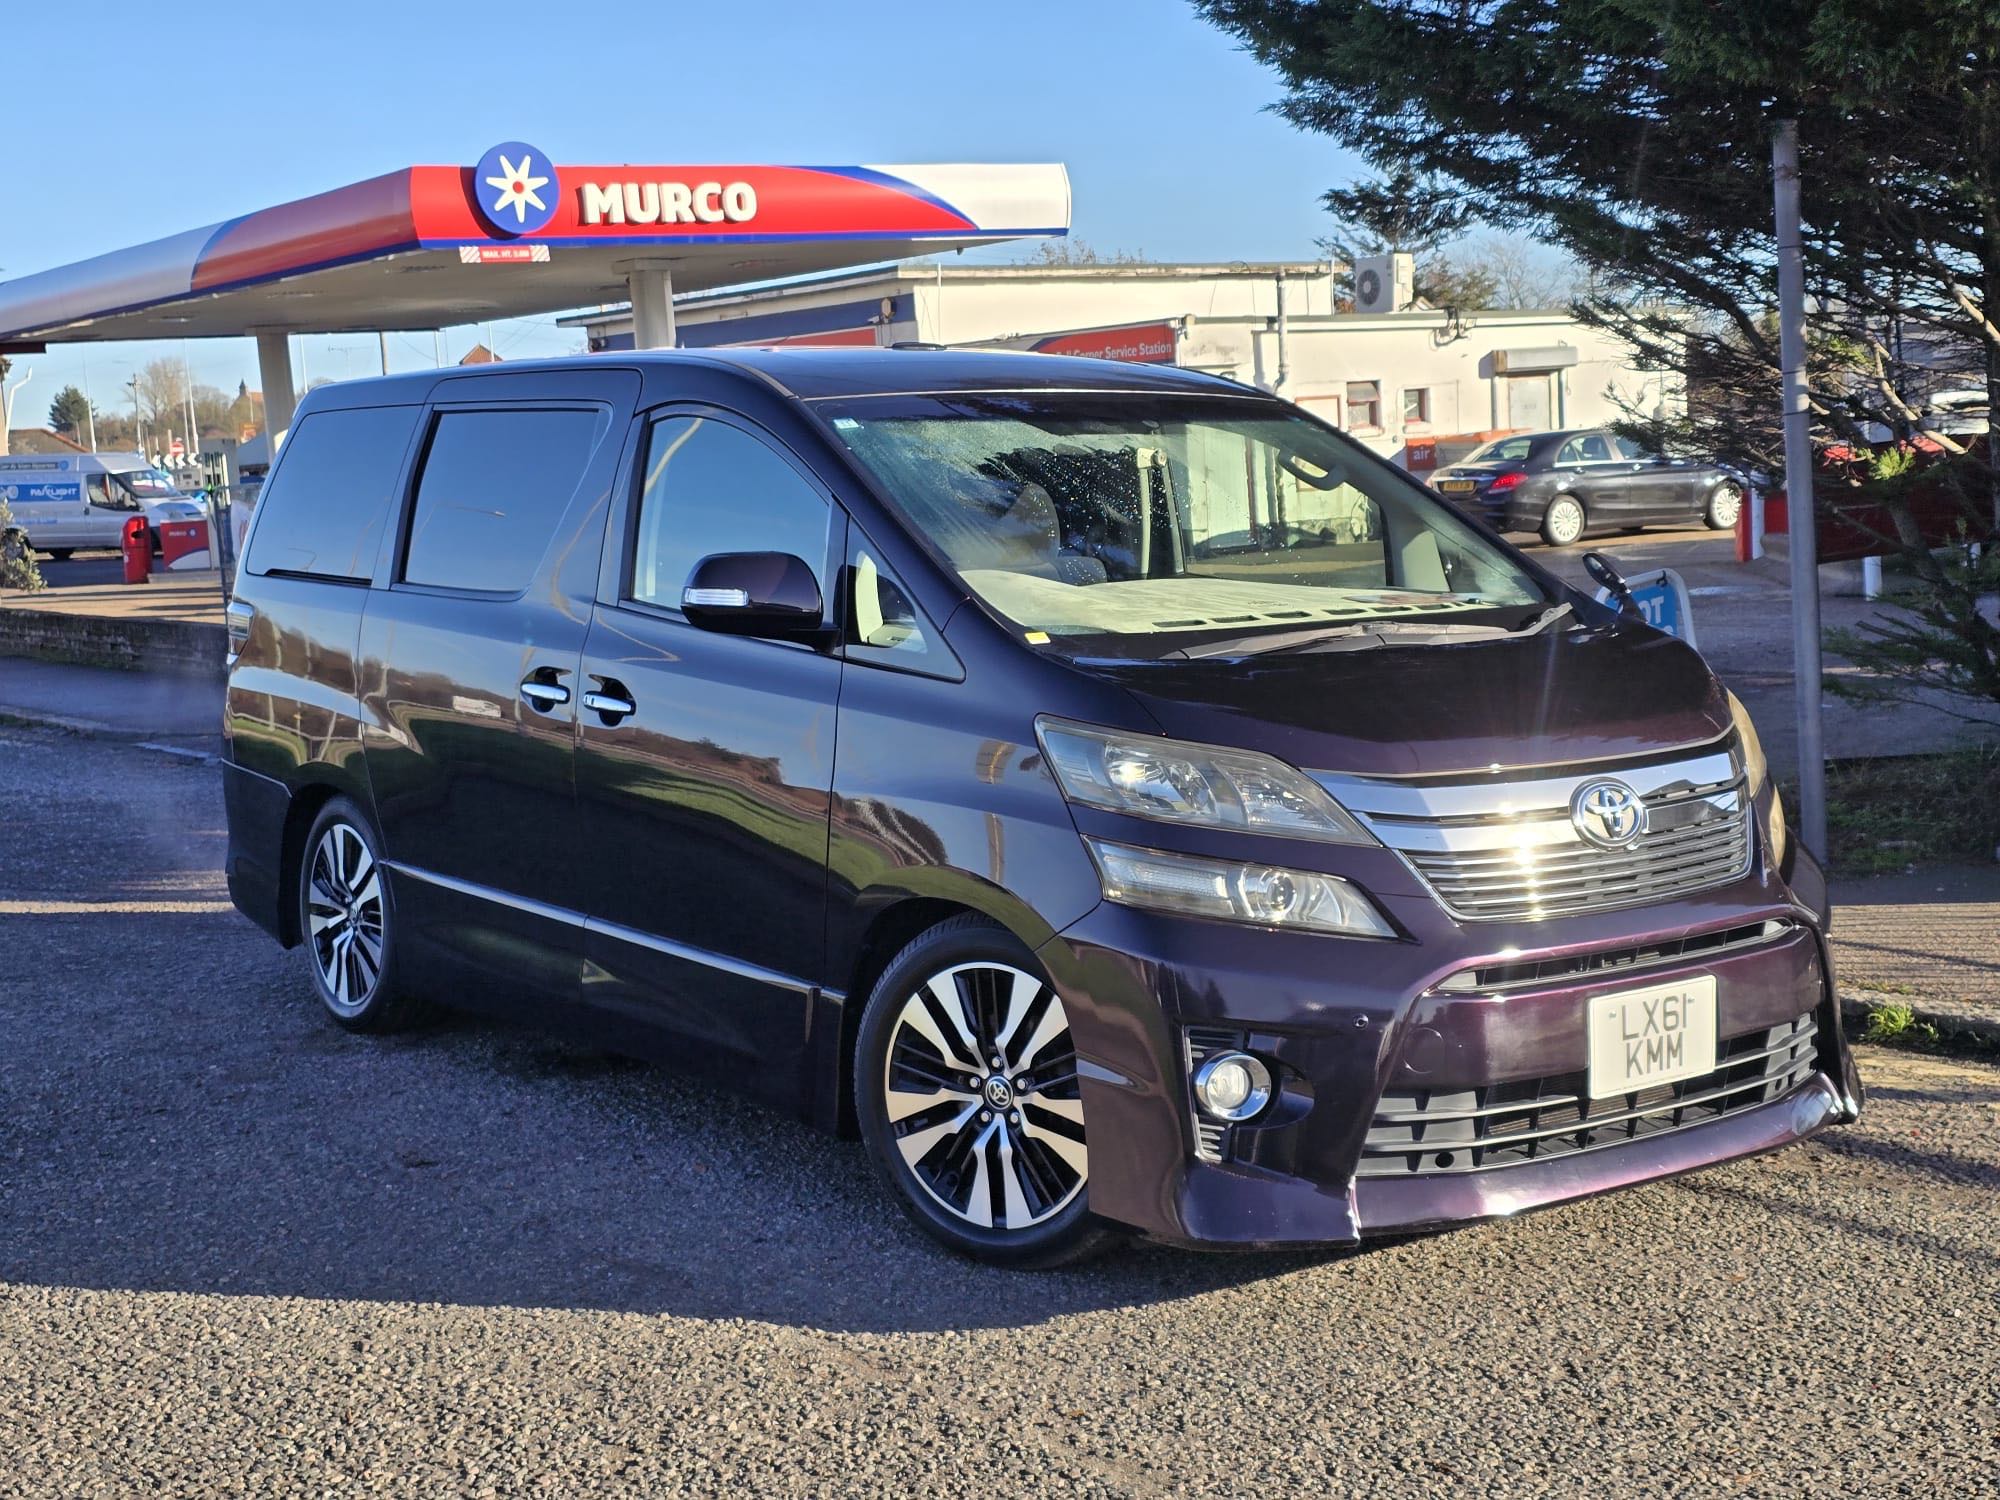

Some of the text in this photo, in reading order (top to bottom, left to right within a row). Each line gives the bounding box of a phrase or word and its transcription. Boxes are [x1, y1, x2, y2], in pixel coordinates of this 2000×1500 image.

[581, 182, 757, 224] MURCO
[1105, 346, 1137, 359] Service
[1139, 341, 1172, 355] Station
[1413, 446, 1430, 460] air
[1622, 993, 1687, 1041] LX61
[1626, 1032, 1683, 1078] KMM
